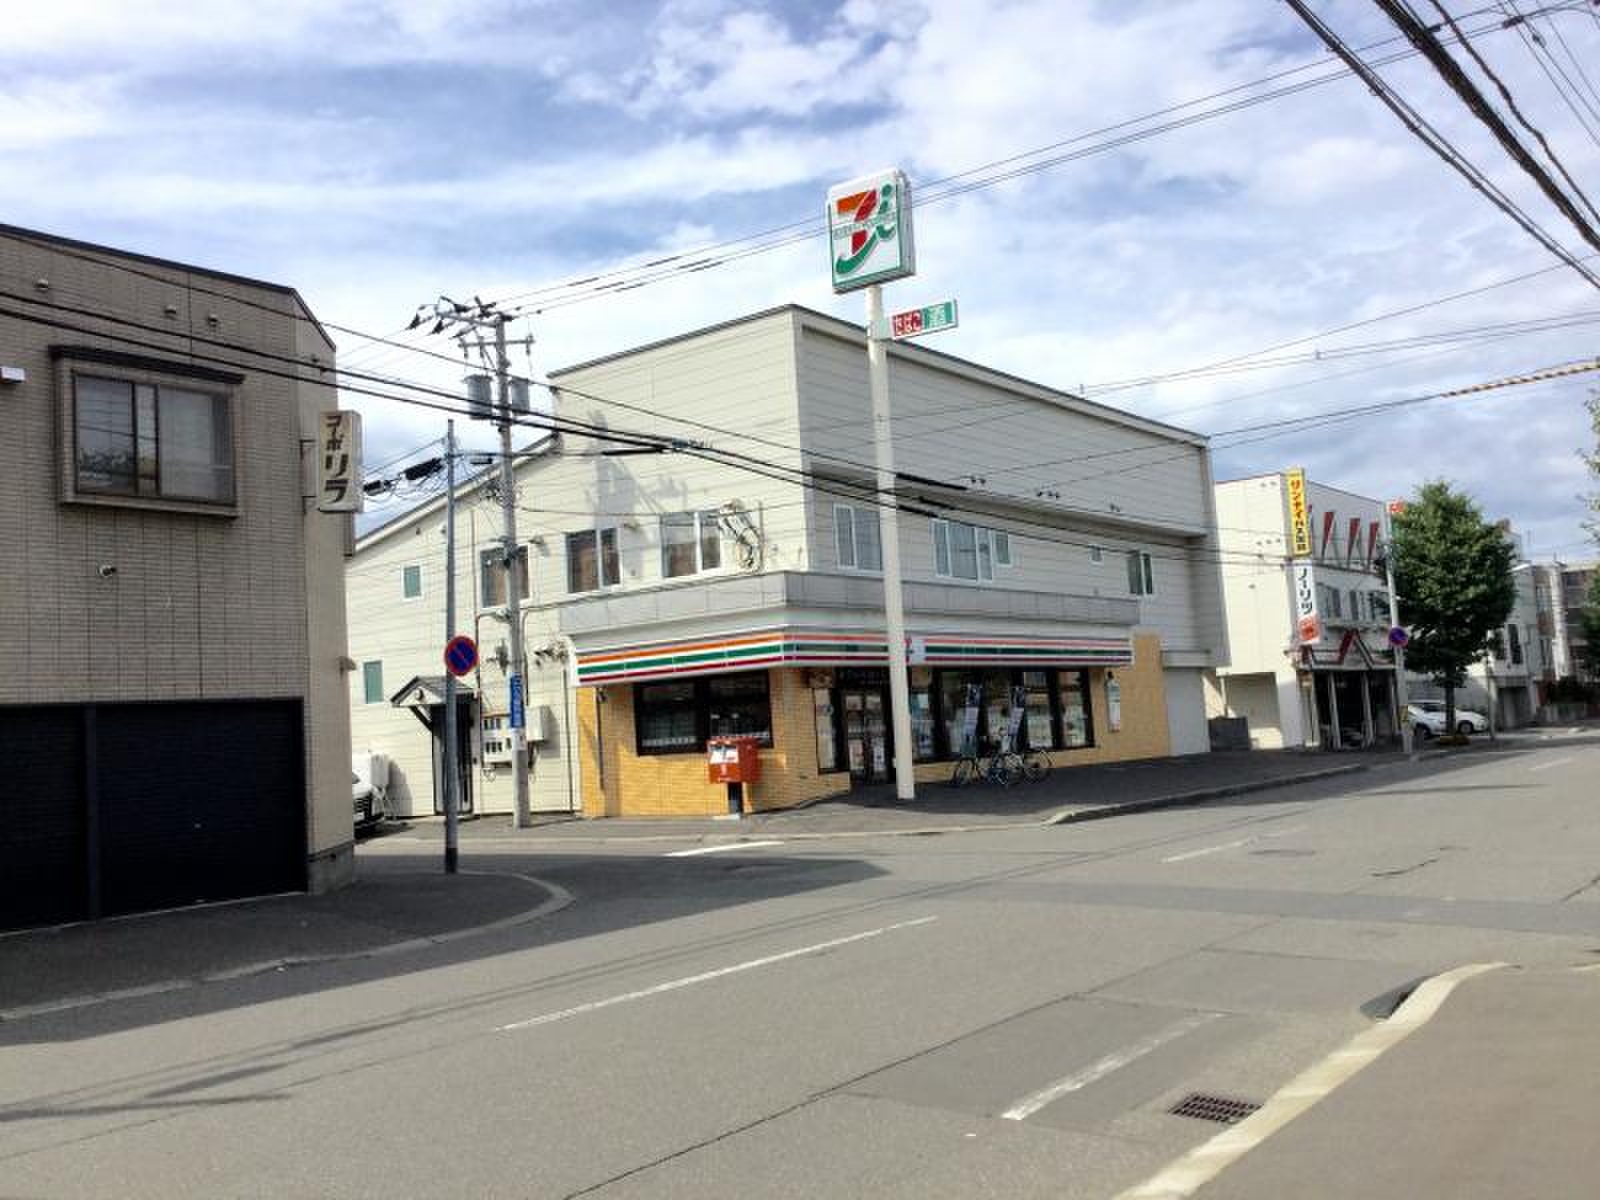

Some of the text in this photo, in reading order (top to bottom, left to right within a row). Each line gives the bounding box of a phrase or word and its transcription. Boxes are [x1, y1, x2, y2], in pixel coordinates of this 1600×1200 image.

[325, 415, 349, 503] コーポリラ
[1298, 567, 1313, 615] ノーリツ
